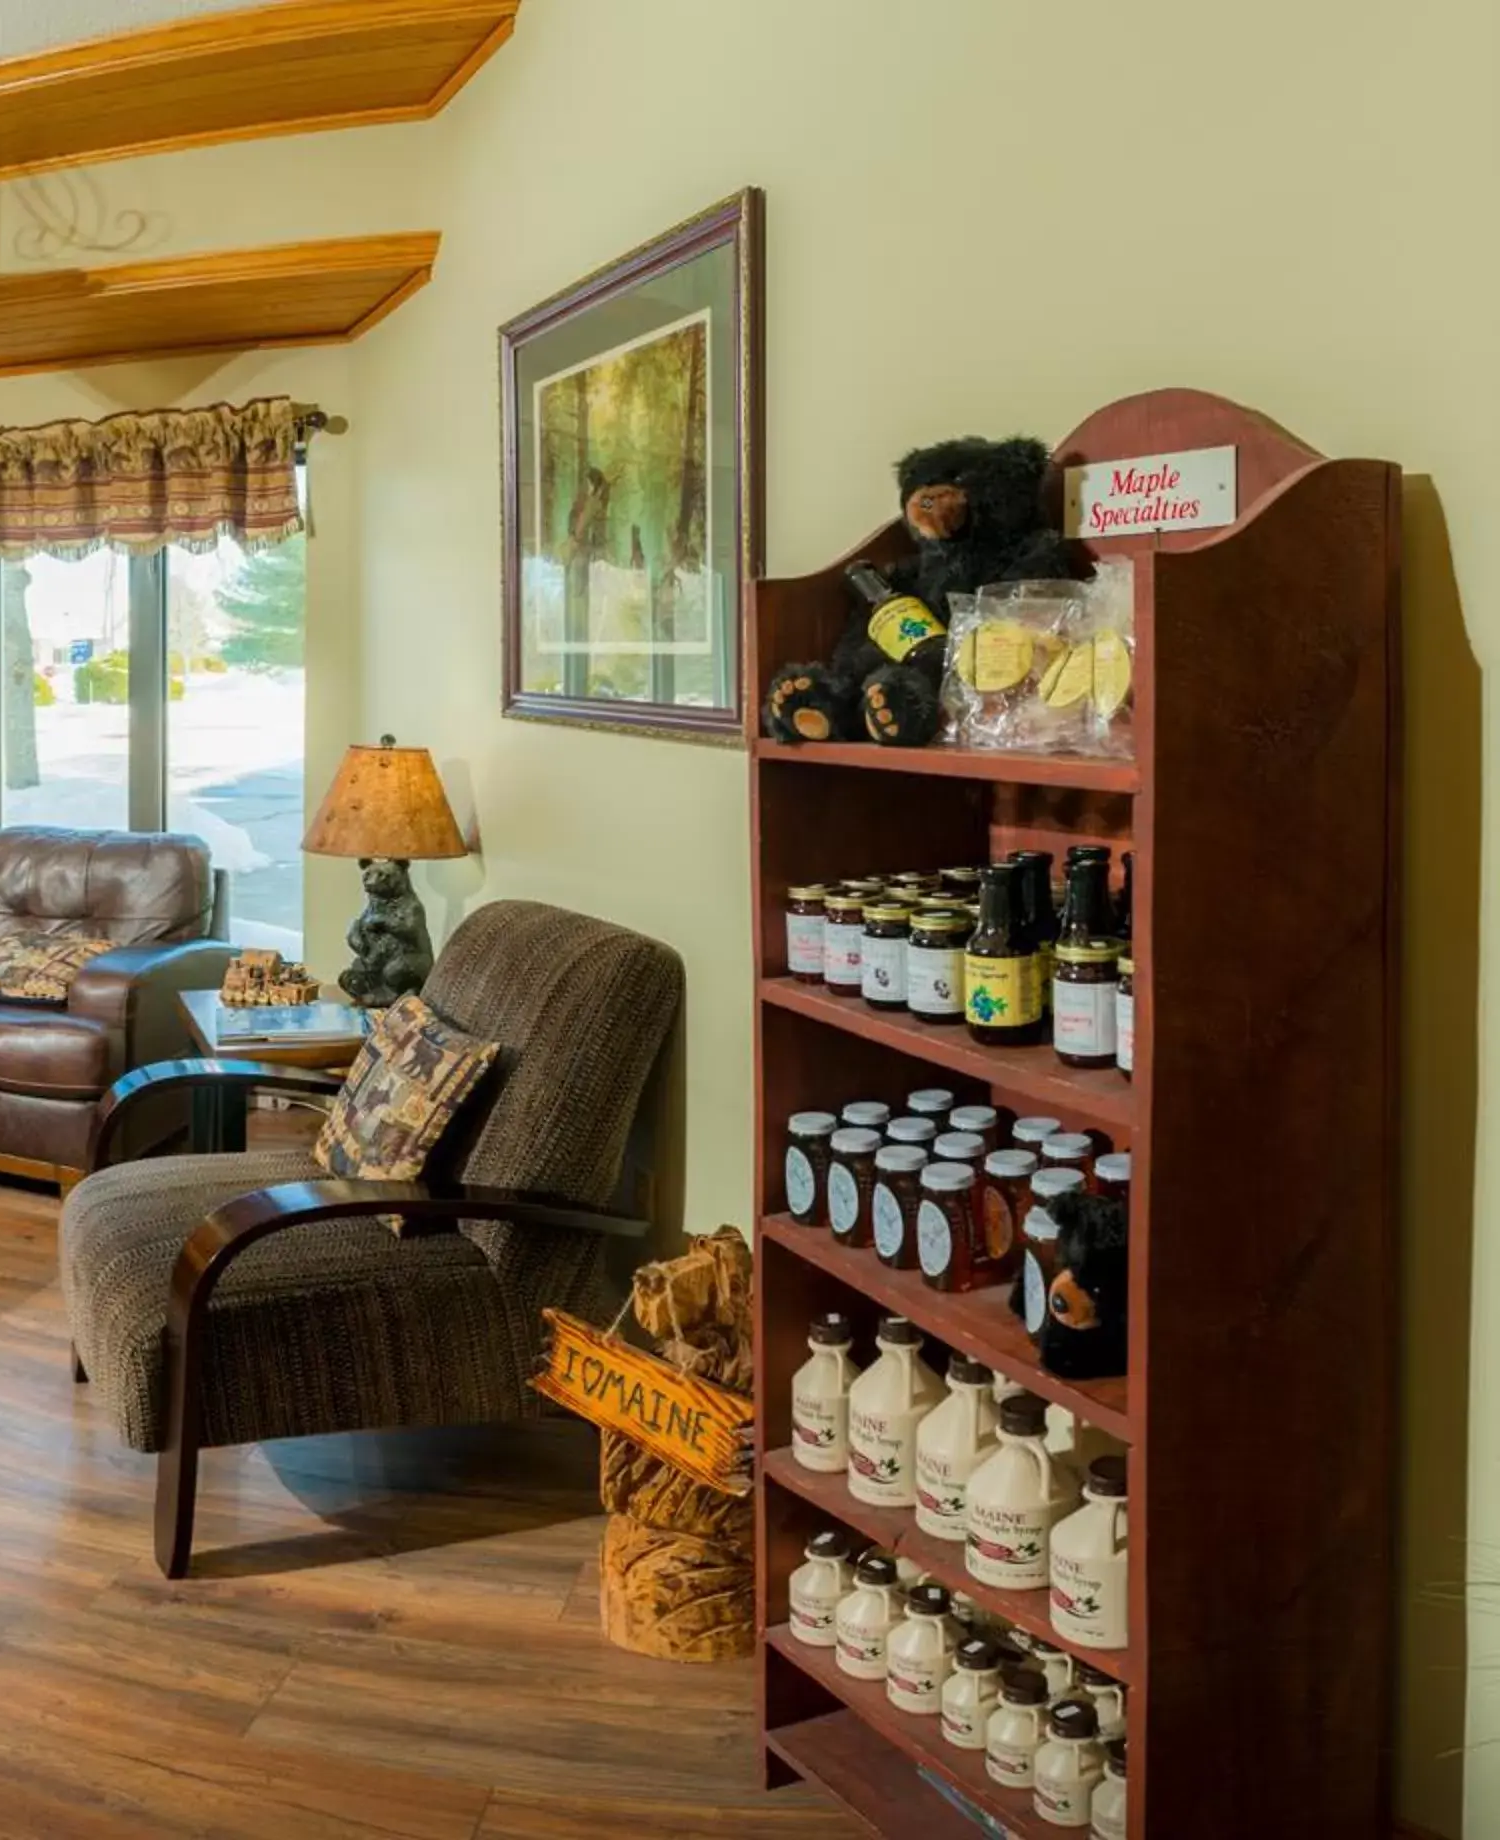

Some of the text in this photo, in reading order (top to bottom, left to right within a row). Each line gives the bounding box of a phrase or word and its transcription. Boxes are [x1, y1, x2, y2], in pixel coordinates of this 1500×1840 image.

[1109, 463, 1180, 497] Maple
[1089, 496, 1200, 532] Specialties
[562, 1347, 713, 1453] I MAINE
[975, 1504, 1026, 1524] MAINE
